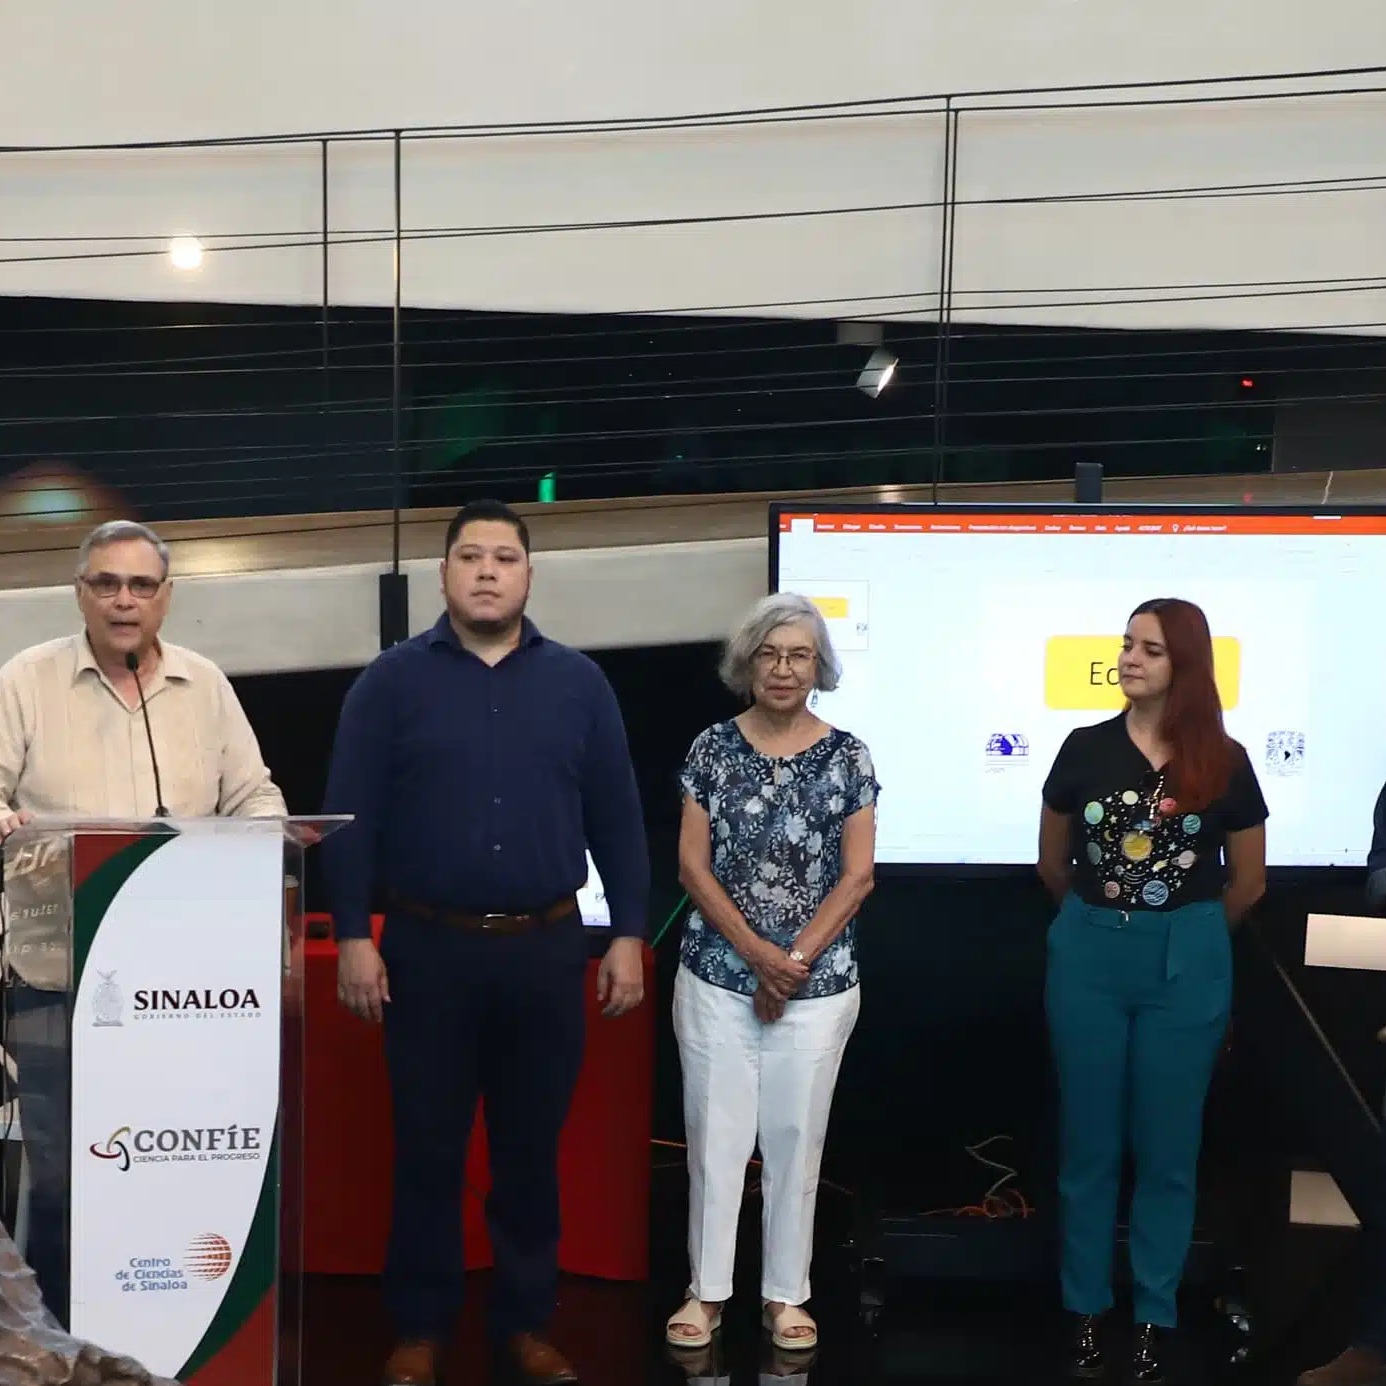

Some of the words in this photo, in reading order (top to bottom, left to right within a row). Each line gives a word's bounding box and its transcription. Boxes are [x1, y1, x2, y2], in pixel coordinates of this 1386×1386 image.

[133, 988, 261, 1011] SINALOA
[133, 1124, 261, 1153] CONFÍE
[133, 1155, 169, 1163] CIENCIA
[173, 1154, 196, 1162] PARA
[211, 1152, 261, 1160] PROGRESO
[129, 1257, 171, 1267] Centro
[115, 1270, 130, 1280] de
[134, 1268, 184, 1280] Ciencias
[121, 1281, 136, 1292] de
[140, 1279, 188, 1291] Sinaloa
